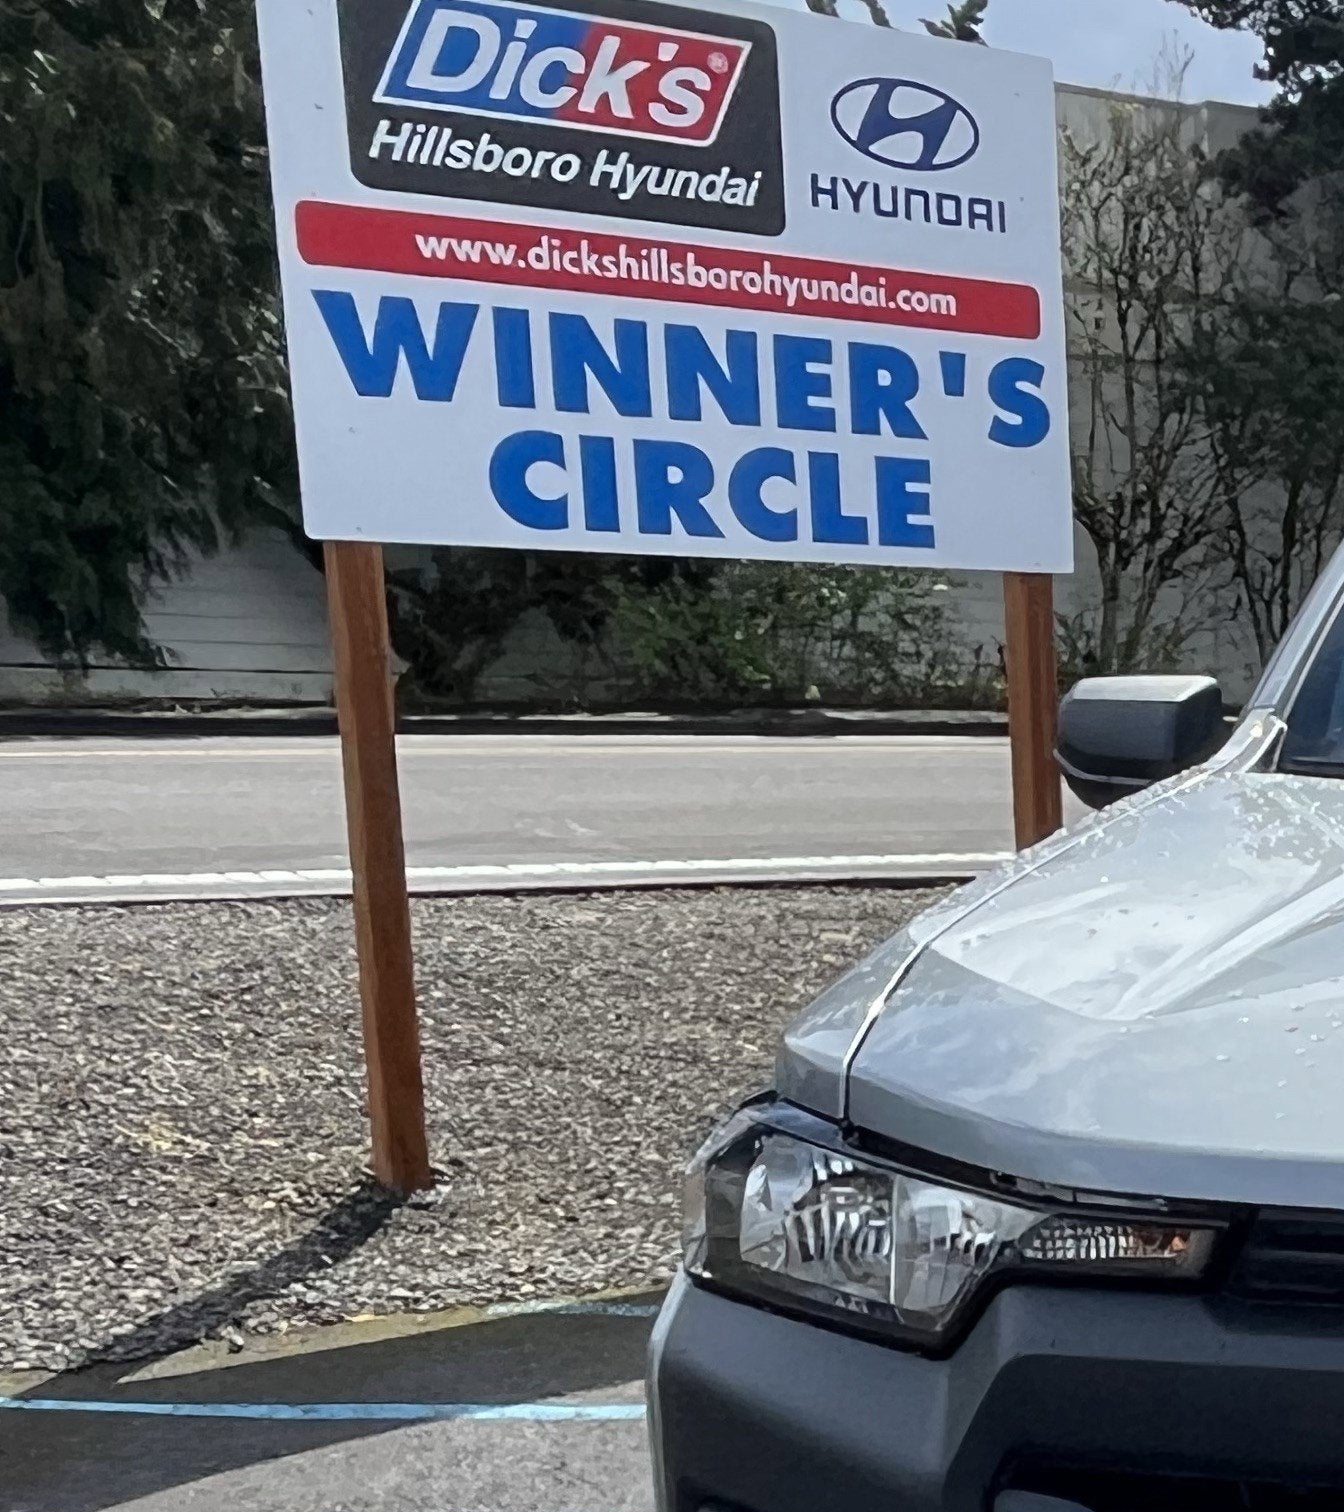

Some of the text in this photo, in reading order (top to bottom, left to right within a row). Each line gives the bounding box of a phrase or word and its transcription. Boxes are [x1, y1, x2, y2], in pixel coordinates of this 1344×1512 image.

[406, 8, 713, 128] Dick's
[368, 119, 763, 207] Hillsboro Hyundai
[810, 173, 1007, 234] HYUNDAI
[414, 229, 958, 317] www.dickshillsborohyundai.com
[311, 289, 1051, 448] WINNER'S
[488, 429, 936, 550] CIRCLE
